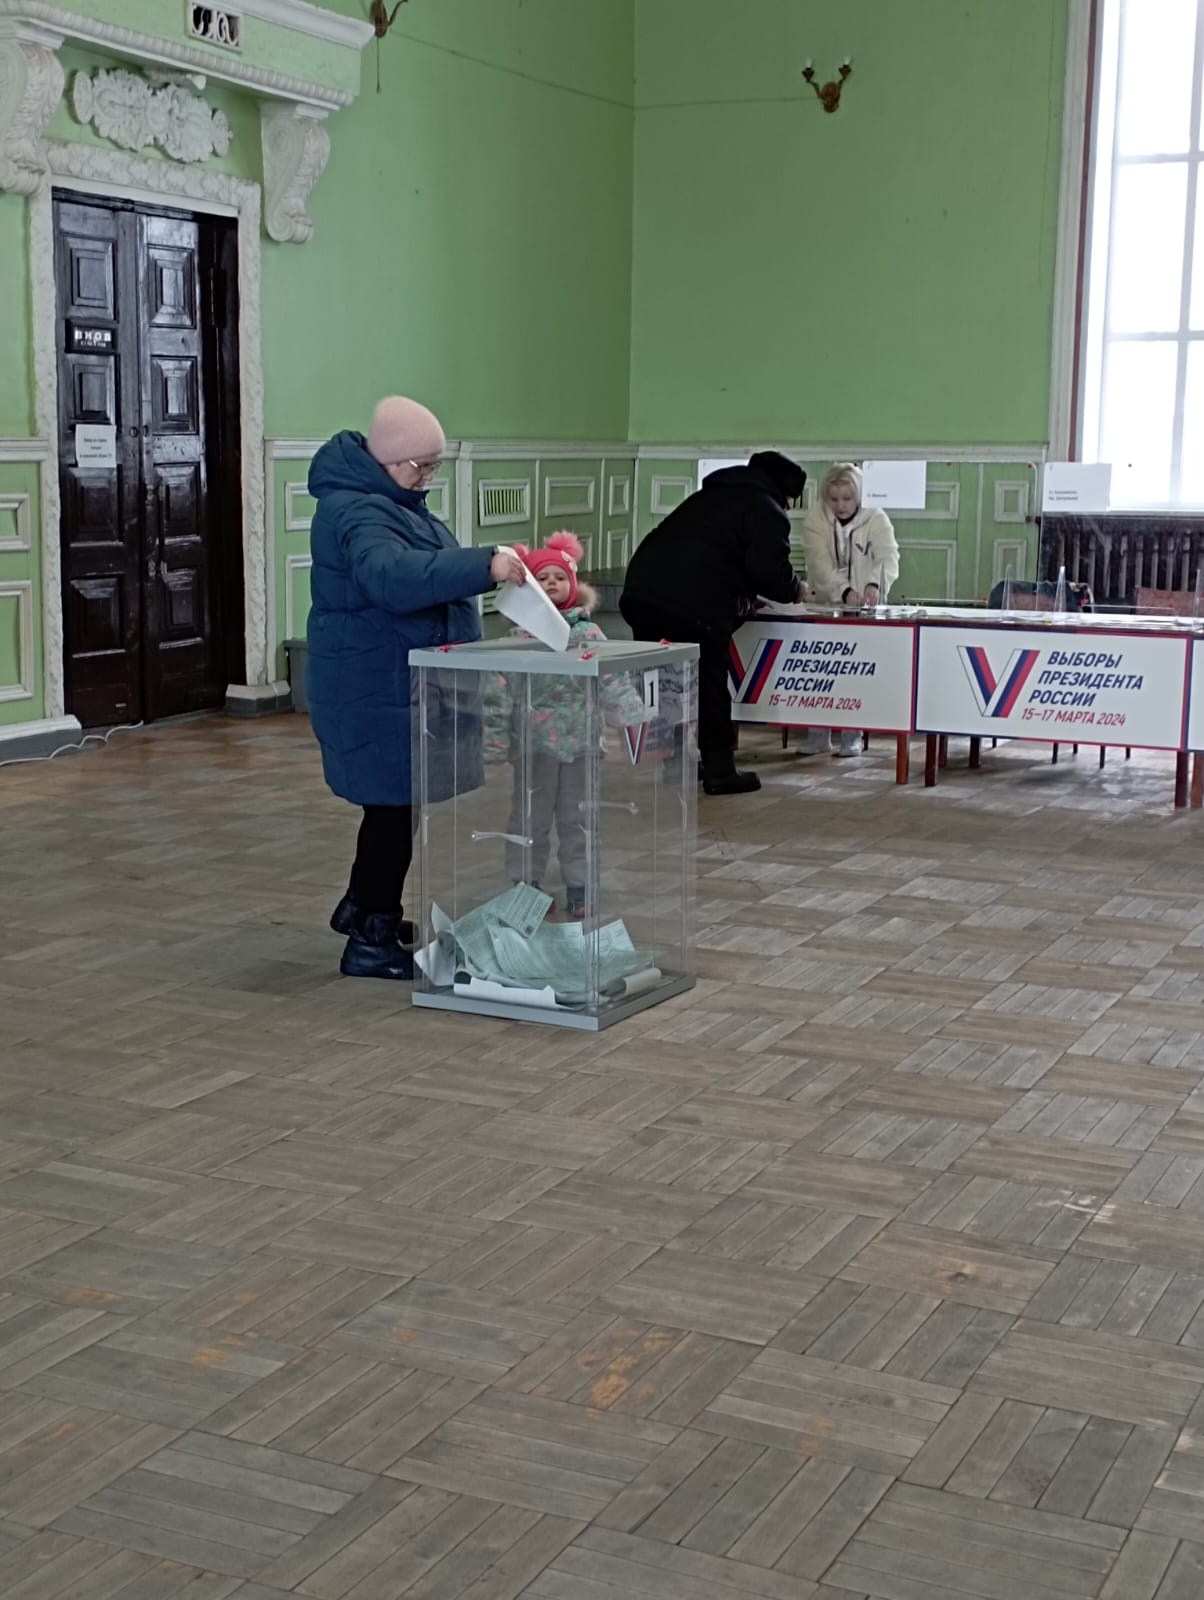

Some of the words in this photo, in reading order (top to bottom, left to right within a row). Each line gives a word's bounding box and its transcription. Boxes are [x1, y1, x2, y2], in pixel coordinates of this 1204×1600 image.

[790, 640, 857, 656] ВЫБОРЫ
[782, 658, 876, 676] ПРЕЗИДЕНТА
[1047, 651, 1123, 669] ВЫБОРЫ
[774, 677, 835, 693] РОССИИ
[1038, 670, 1144, 690] ПРЕЗИДЕНТА
[648, 680, 655, 708] 1
[1028, 689, 1096, 707] РОССИИ
[798, 696, 834, 709] МАРТА
[835, 698, 862, 711] 2024
[1054, 711, 1095, 725] МАРТА
[1096, 713, 1126, 727] 2024
